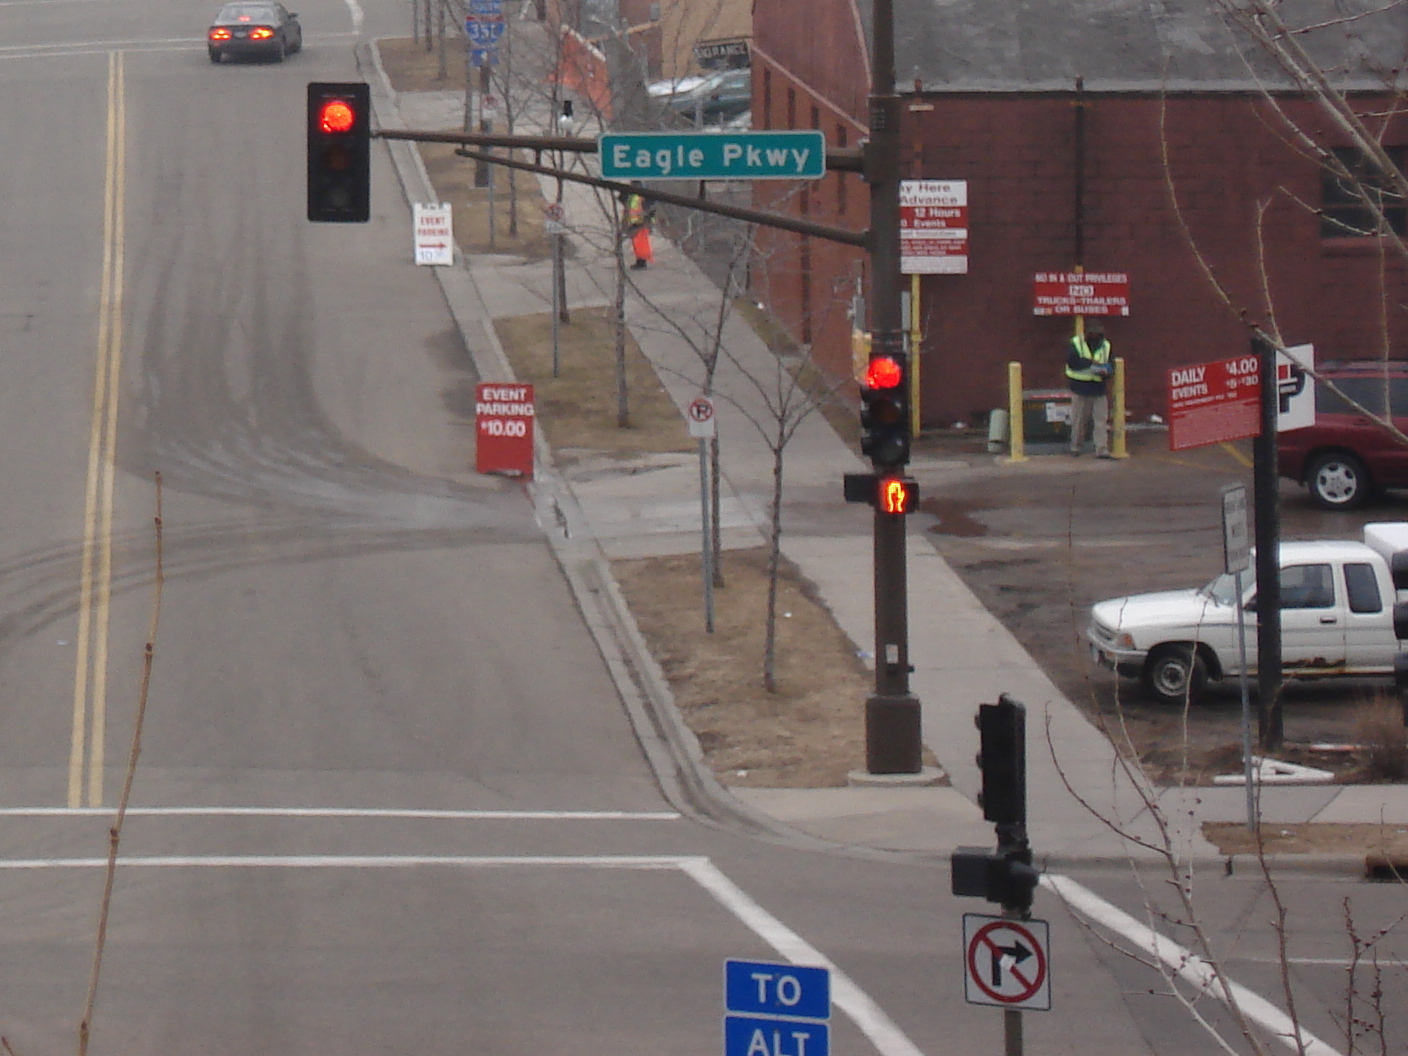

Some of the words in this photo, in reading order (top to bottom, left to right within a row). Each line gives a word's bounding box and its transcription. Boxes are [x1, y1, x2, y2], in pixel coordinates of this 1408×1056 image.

[613, 144, 705, 175] Eagle
[723, 144, 810, 172] Pkwy
[919, 183, 951, 192] Here
[901, 195, 958, 204] Advance
[930, 207, 961, 218] Hours
[420, 216, 445, 225] EVENT
[914, 219, 947, 228] Events
[418, 228, 449, 236] PARKING
[1085, 273, 1127, 283] PRIVILEGES
[1071, 286, 1093, 295] NO
[1055, 305, 1070, 313] OR
[1073, 305, 1108, 314] BUSES
[1171, 366, 1206, 387] DAILY
[482, 387, 527, 401] EVENT
[1172, 382, 1208, 401] EVENTS
[476, 402, 534, 415] PARKING
[751, 972, 802, 1006] TO
[747, 1028, 810, 1056] ALT
